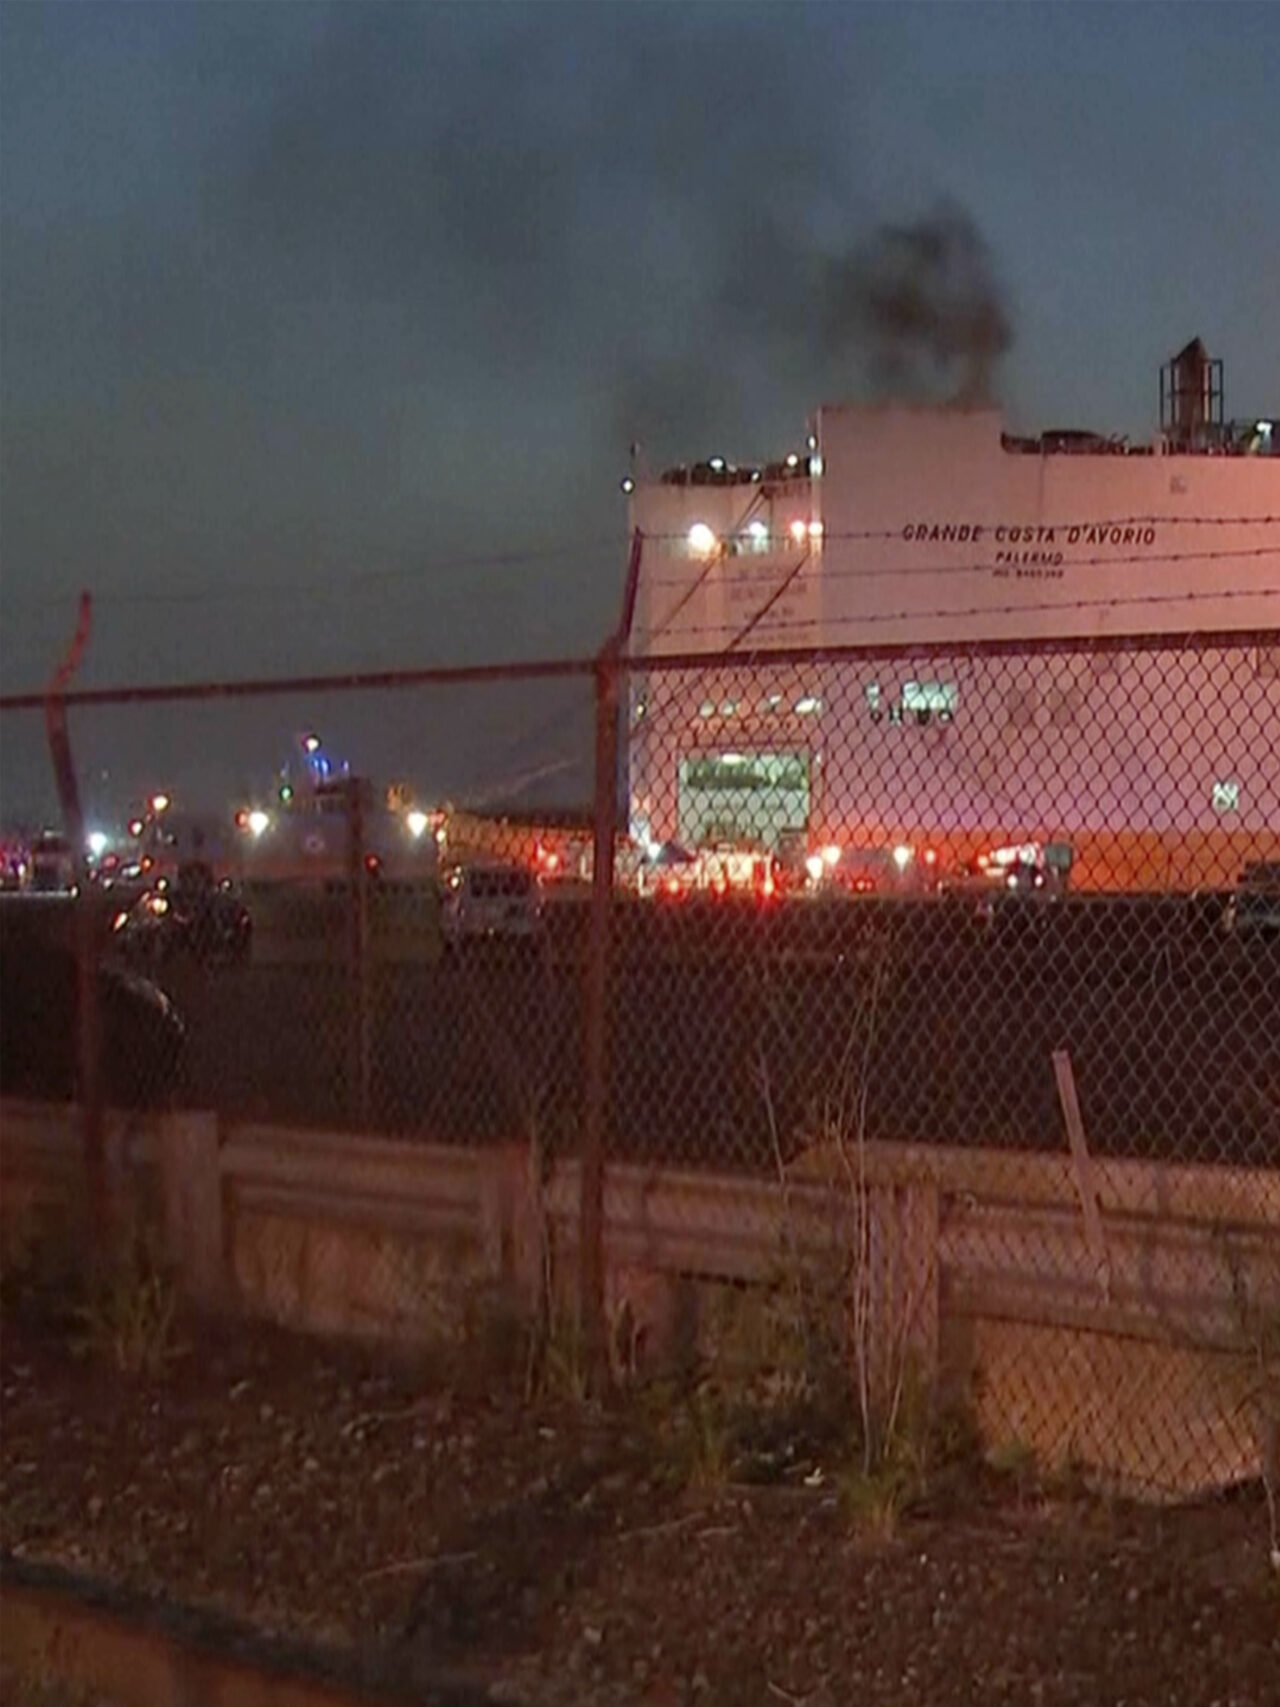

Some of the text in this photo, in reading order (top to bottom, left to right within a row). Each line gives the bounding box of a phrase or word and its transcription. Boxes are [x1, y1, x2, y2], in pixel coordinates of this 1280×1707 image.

[902, 524, 1157, 545] GRANDE COSTA D'AVORIO
[996, 551, 1064, 567] PALERMO
